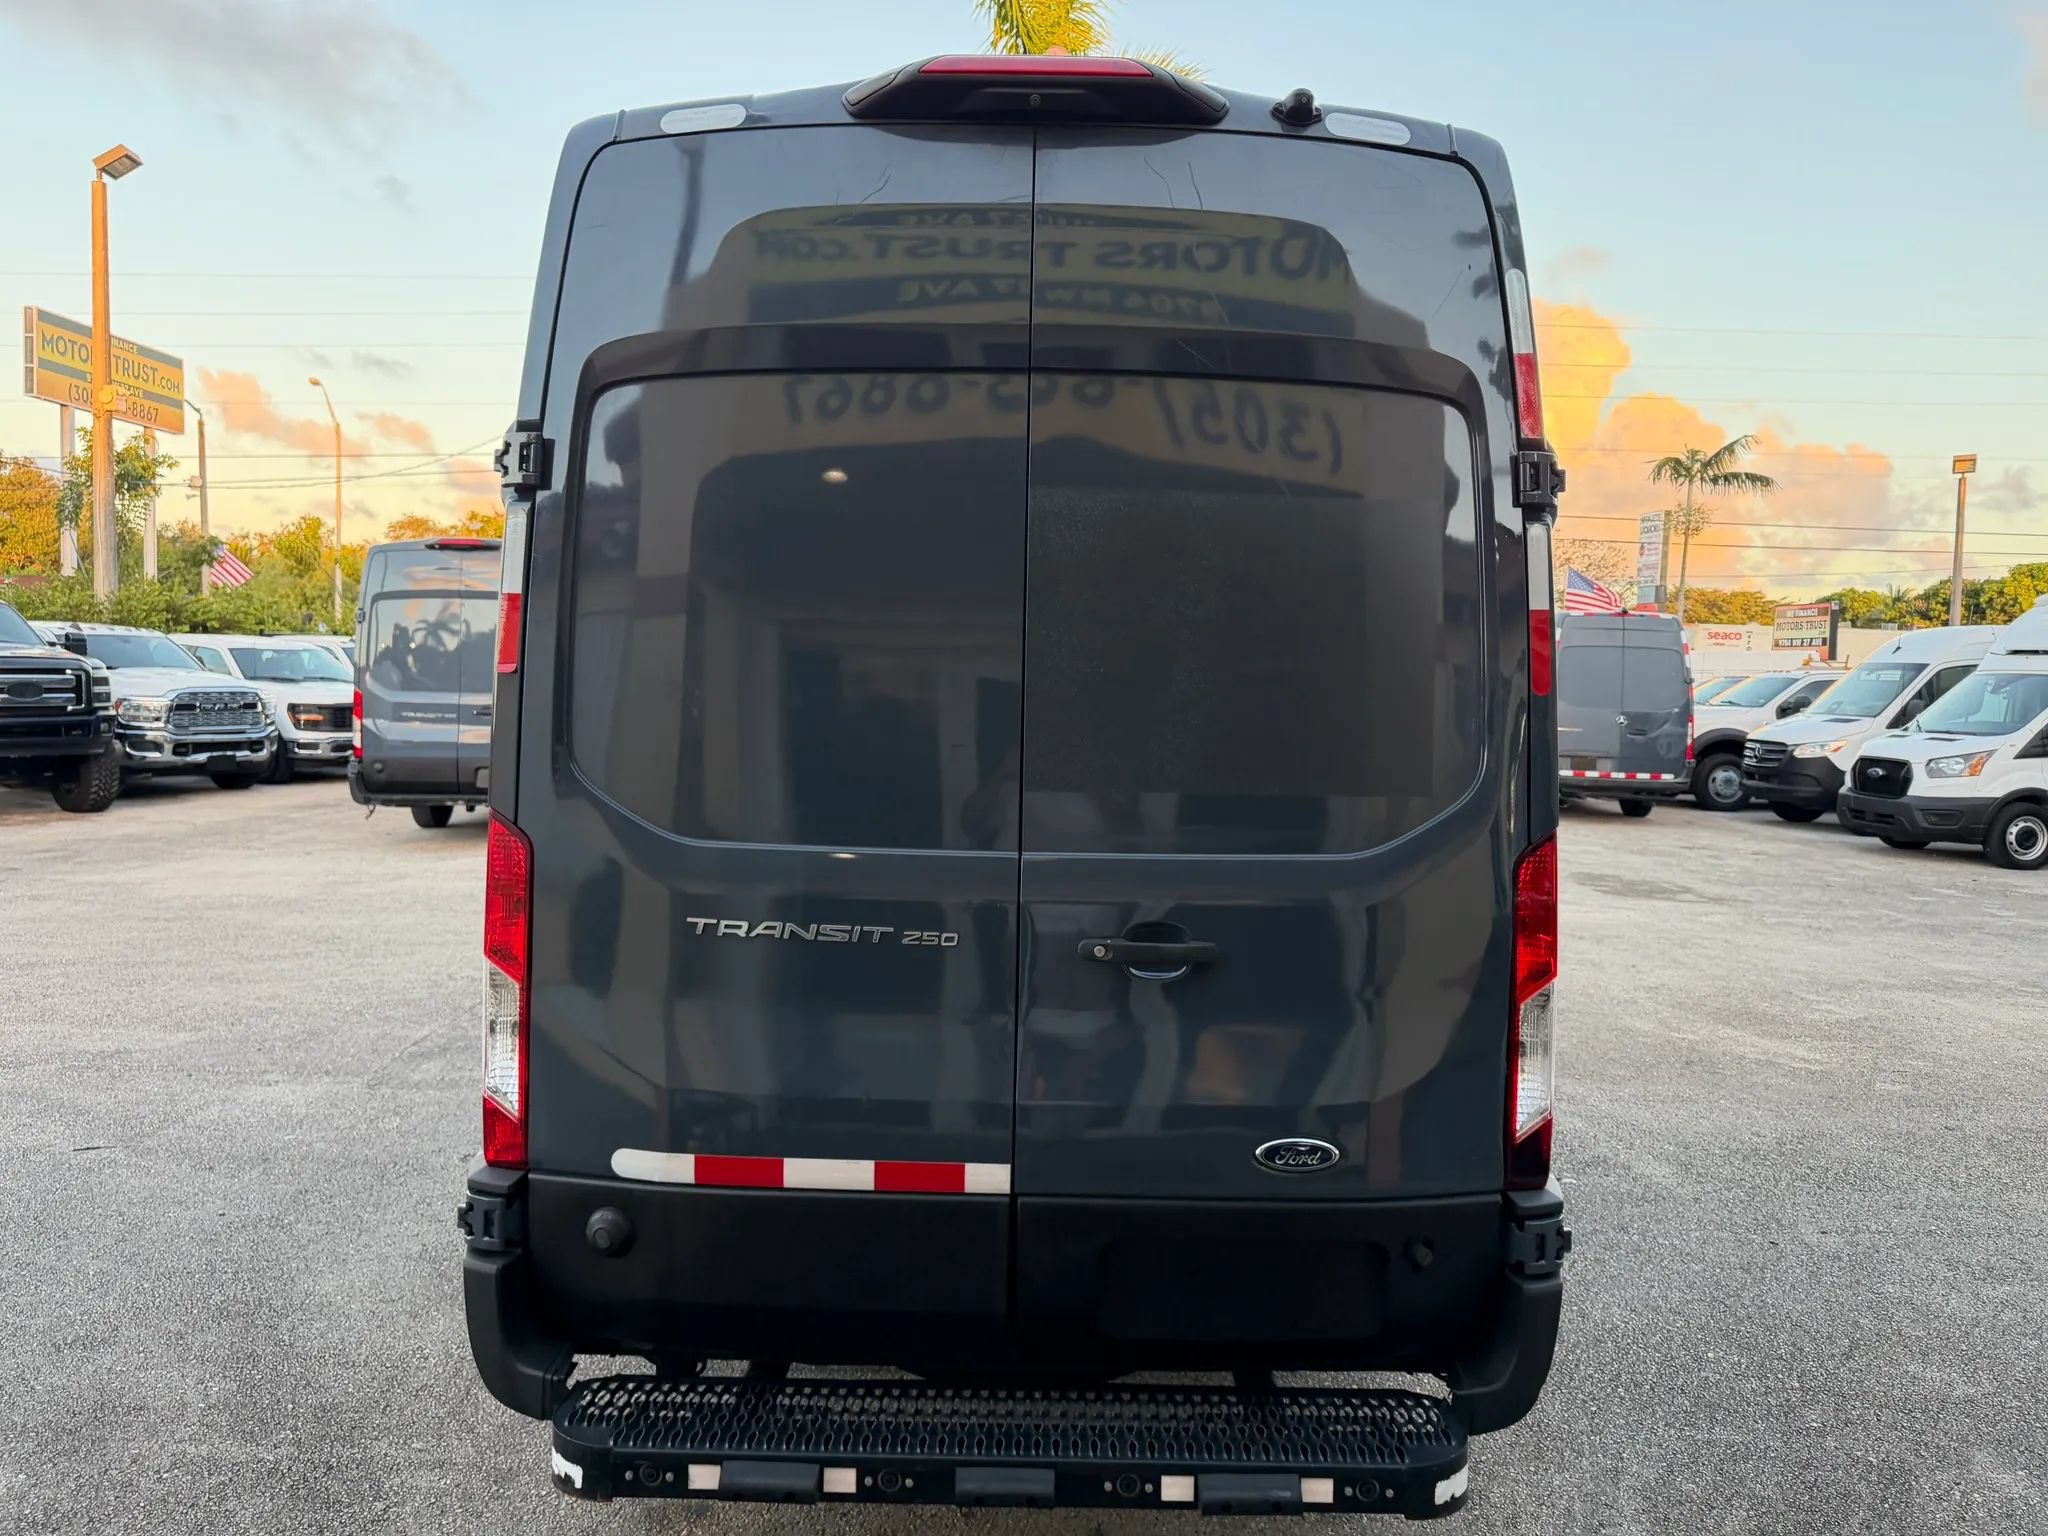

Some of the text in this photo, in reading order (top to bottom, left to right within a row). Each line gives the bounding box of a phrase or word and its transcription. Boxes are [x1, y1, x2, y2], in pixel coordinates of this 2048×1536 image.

[42, 329, 181, 393] MOTO TRUST.COM
[1776, 619, 1828, 631] MOTORS TRUST
[1707, 631, 1743, 641] seaco
[686, 917, 960, 947] TRANSIT 250
[1274, 1144, 1322, 1165] Ford
